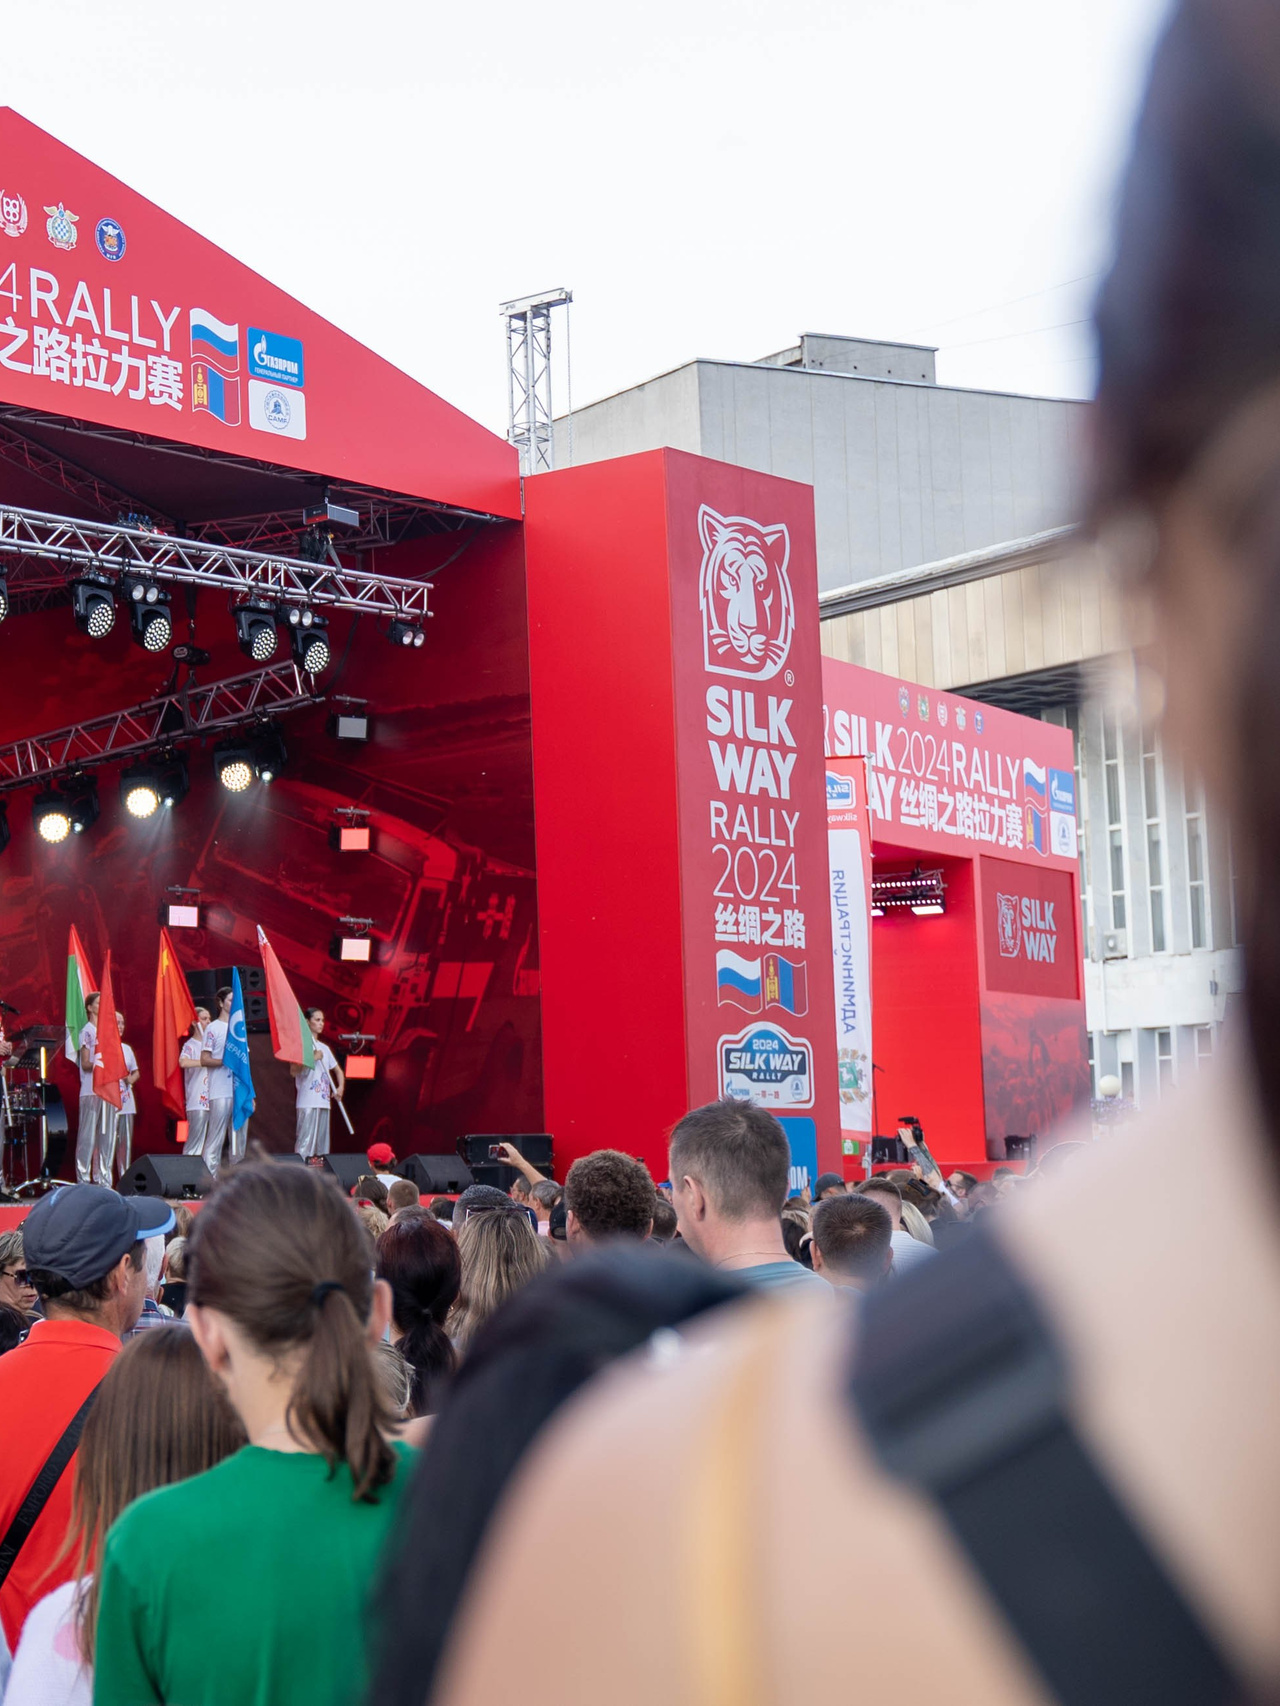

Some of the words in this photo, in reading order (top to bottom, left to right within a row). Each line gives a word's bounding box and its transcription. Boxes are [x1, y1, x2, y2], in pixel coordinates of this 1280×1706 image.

[30, 274, 181, 353] RALLY
[706, 684, 797, 748] SILK
[833, 709, 896, 772] SILK
[707, 739, 798, 800] WAY
[897, 727, 951, 783] 2024
[952, 741, 1020, 800] RALLY
[869, 771, 896, 821] AY
[899, 777, 1023, 851] 丝绸之路拉力赛
[710, 799, 800, 848] RALLY
[711, 843, 801, 904] 2024
[714, 902, 806, 949] 丝绸之路
[1021, 896, 1057, 931] SILK
[1022, 929, 1057, 963] WAY
[729, 1051, 768, 1070] SILK
[770, 1053, 803, 1072] WAY
[752, 1038, 779, 1051] 2024
[752, 1071, 782, 1081] RALLY
